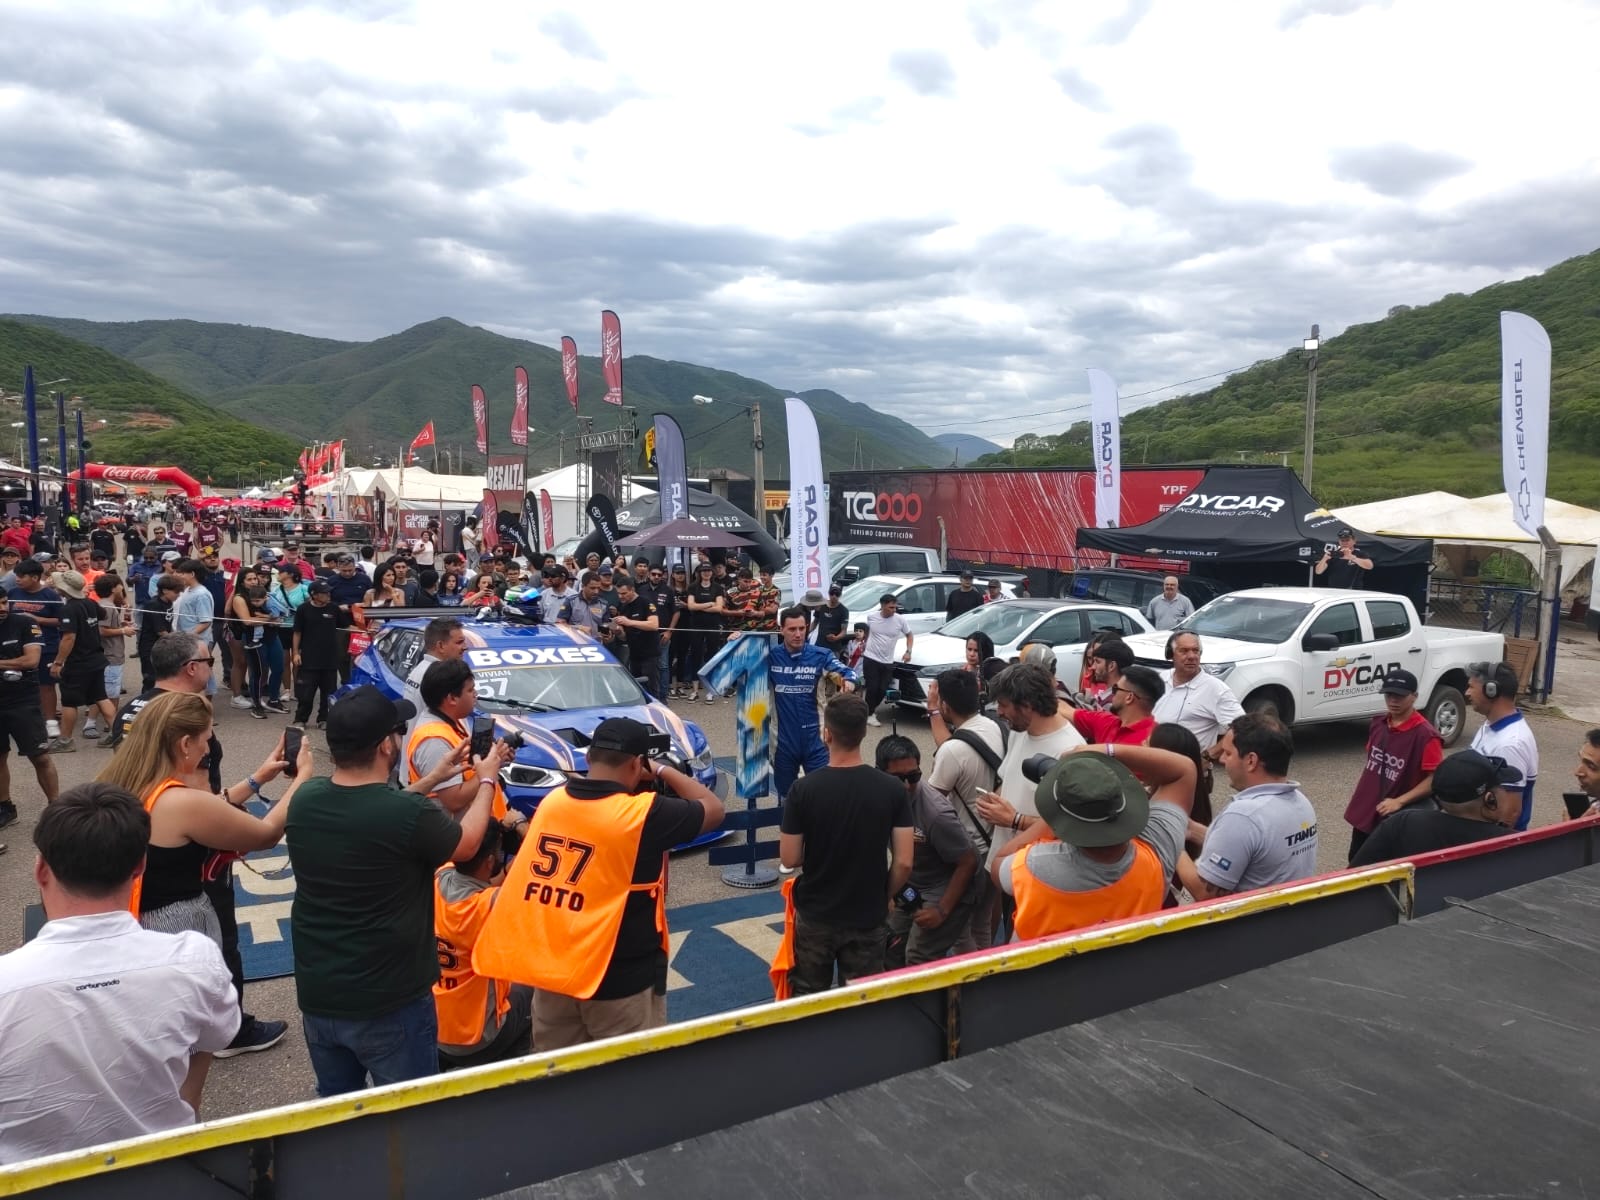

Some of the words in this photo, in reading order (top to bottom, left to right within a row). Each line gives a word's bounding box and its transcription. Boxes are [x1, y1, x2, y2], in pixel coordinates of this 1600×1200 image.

[102, 466, 158, 480] Coca-Cola
[487, 463, 524, 490] RESALTA
[1161, 485, 1188, 495] YPF
[842, 491, 922, 522] TC2000
[1177, 494, 1286, 513] DYCAR
[849, 529, 874, 537] TURISMO
[875, 530, 913, 539] COMPETICIÓN
[1166, 549, 1219, 557] CHEVROLET
[468, 647, 606, 666] BOXES
[478, 669, 512, 678] VIVIAN
[784, 666, 816, 674] ELAION
[475, 678, 509, 699] 57
[1323, 686, 1375, 698] CONCESIONARIO
[530, 832, 595, 886] 57
[524, 882, 585, 912] FOTO
[75, 979, 120, 991] carburando
